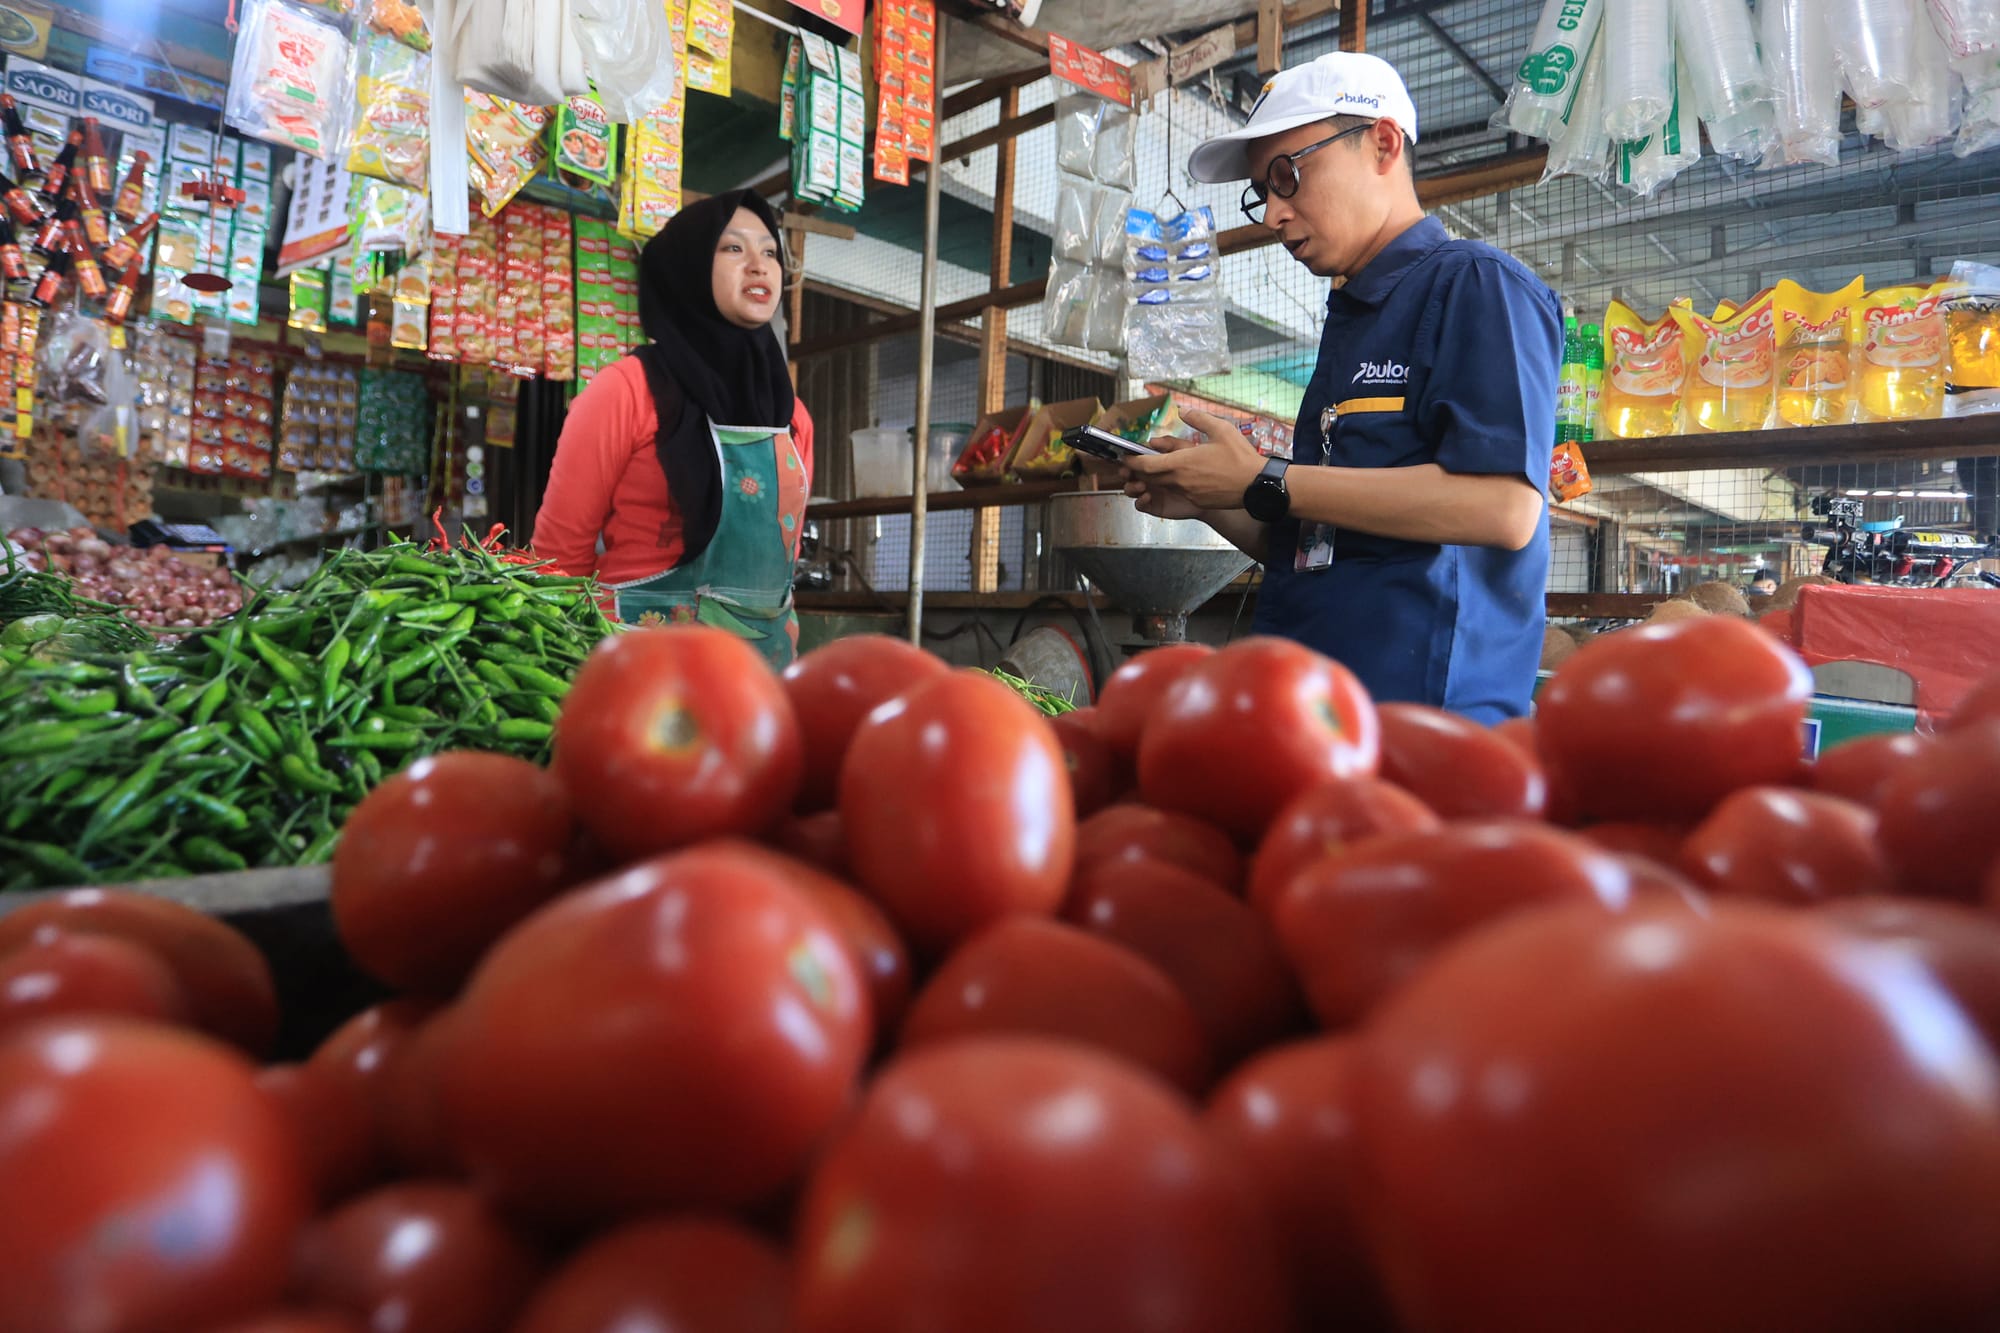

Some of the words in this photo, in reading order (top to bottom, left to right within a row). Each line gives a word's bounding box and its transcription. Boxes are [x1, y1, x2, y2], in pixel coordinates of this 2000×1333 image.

[1538, 52, 1567, 88] 118
[13, 75, 76, 105] SAORI
[1344, 92, 1379, 109] bulog
[87, 94, 145, 124] SAORI
